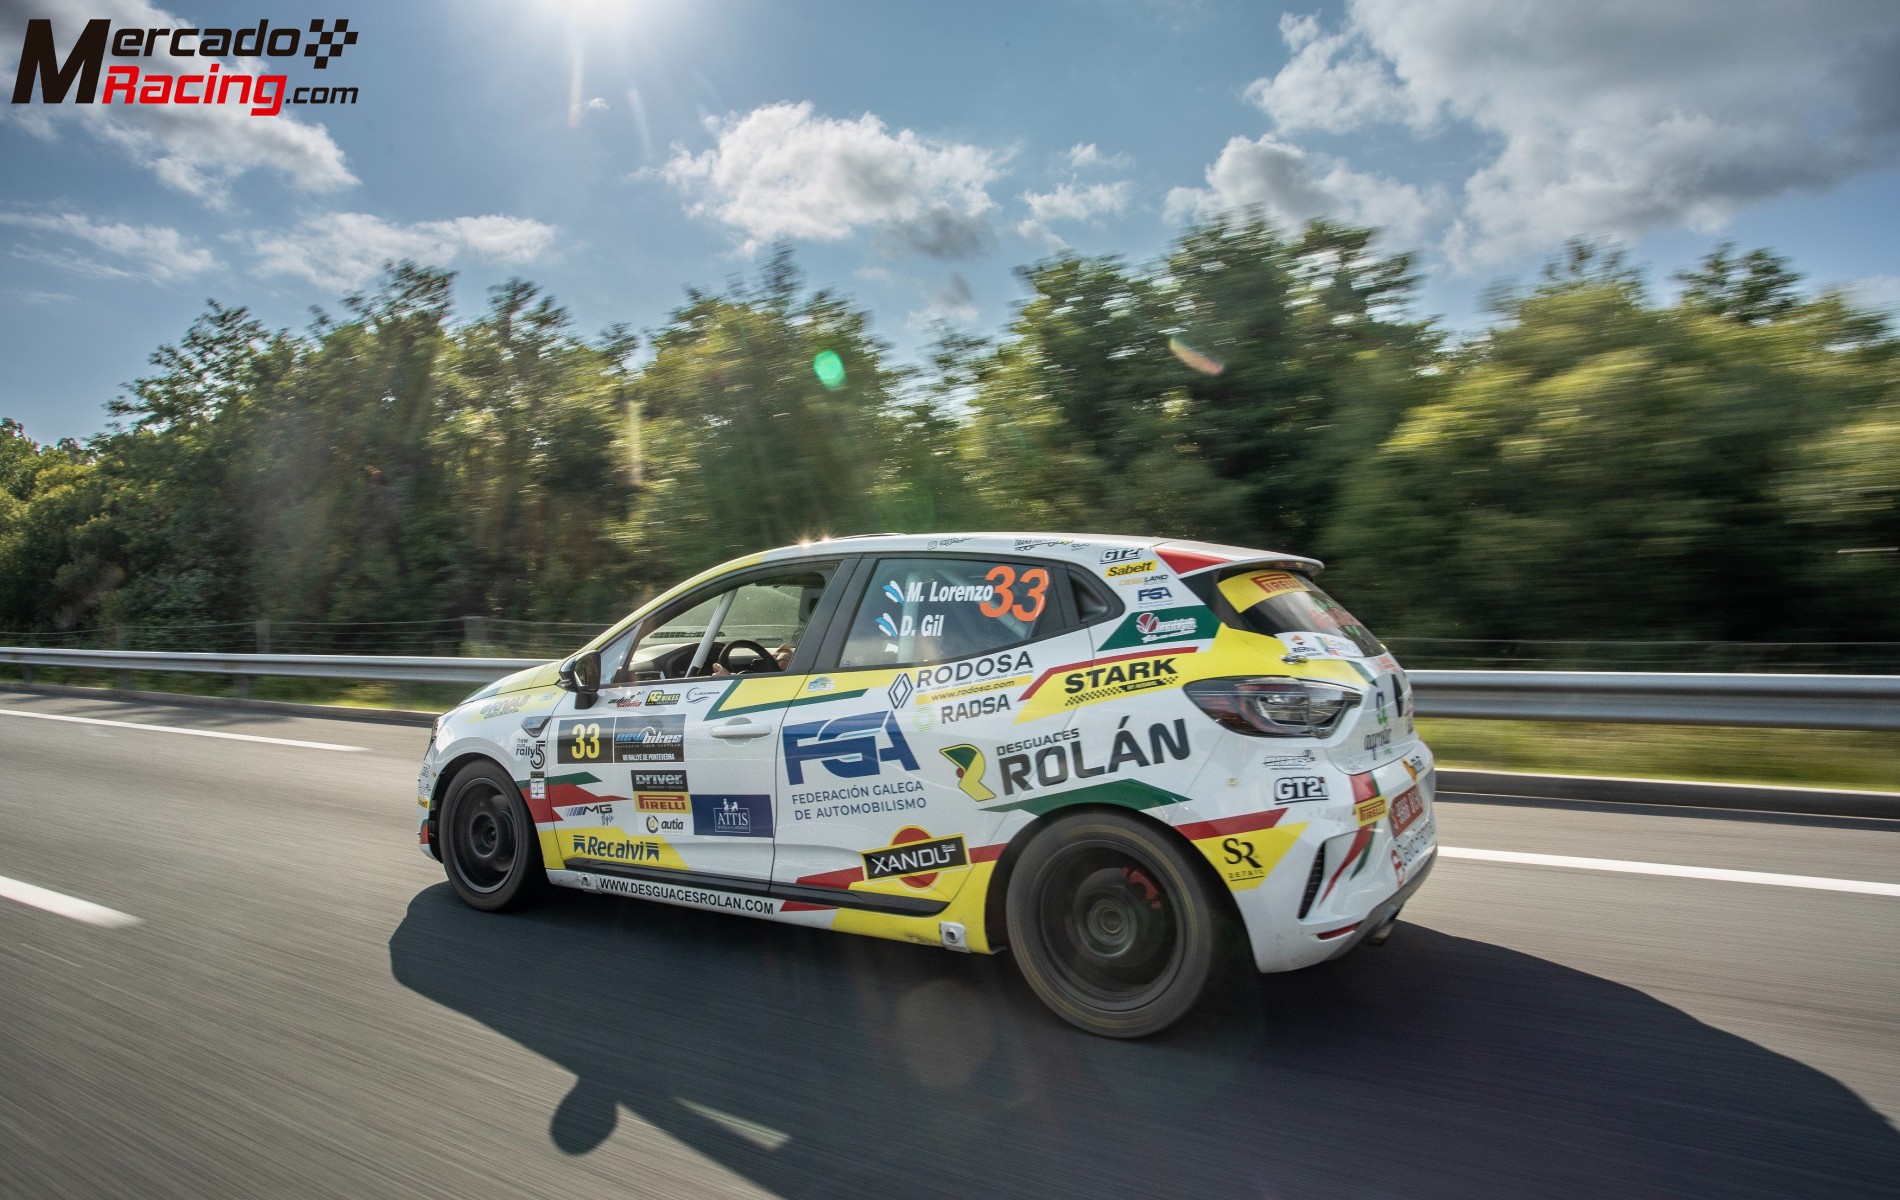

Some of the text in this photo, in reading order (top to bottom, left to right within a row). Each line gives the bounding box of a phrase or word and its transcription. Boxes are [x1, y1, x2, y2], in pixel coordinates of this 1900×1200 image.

[905, 581, 994, 602] M. Lorenzo
[979, 565, 1049, 622] 33
[899, 614, 944, 637] D. Gil
[917, 651, 1034, 688] RODOSA
[1064, 657, 1178, 694] STARK
[931, 680, 1015, 701] www.rodosa.com
[941, 694, 1011, 724] RADSA
[571, 723, 600, 759] 33
[782, 710, 921, 786] FGA
[996, 728, 1080, 756] DESGUACES
[998, 715, 1191, 796] ROLÁN
[637, 795, 686, 810] PIRELLI
[792, 780, 925, 805] FEDERACIÓN GALEGA
[582, 804, 613, 815] MG
[717, 812, 748, 826] ATTIS
[794, 797, 927, 821] DE AUTOMOBILISMO
[661, 818, 684, 830] autia
[588, 836, 645, 860] Recalvi
[873, 847, 951, 875] XANDU
[1222, 838, 1264, 869] SR
[599, 877, 774, 915] WWW.DESGUACESROLAN.COM
